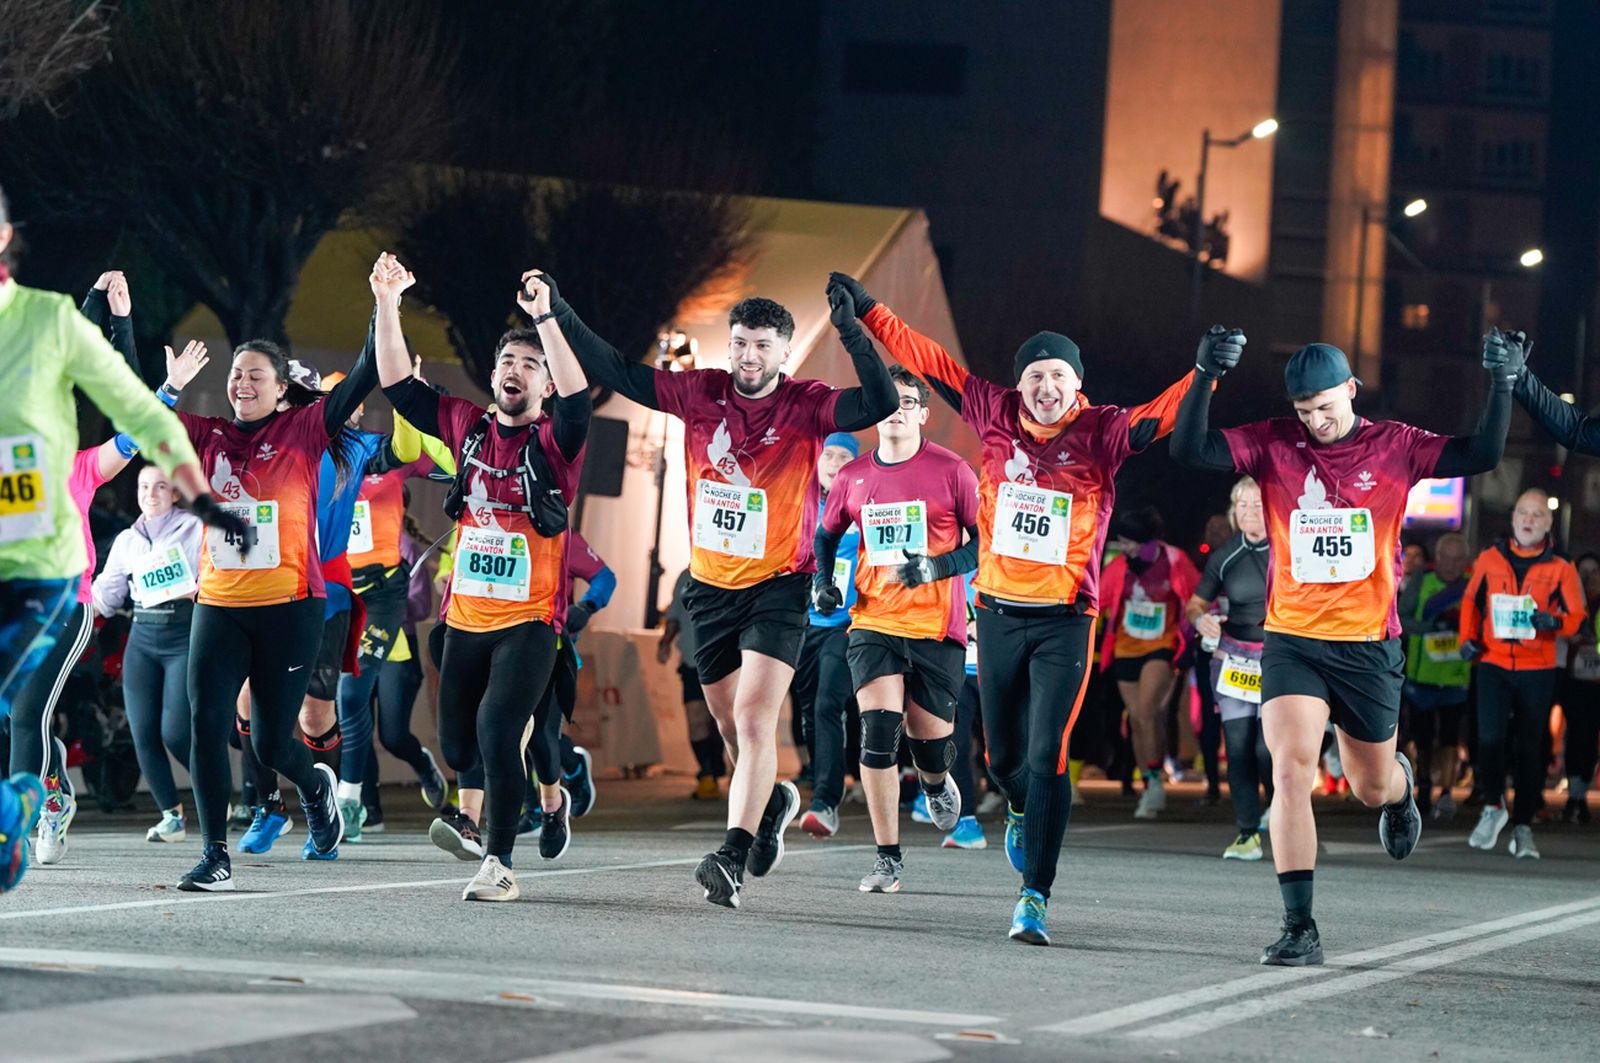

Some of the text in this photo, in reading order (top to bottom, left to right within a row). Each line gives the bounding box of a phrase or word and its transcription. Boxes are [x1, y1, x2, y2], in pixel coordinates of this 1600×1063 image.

[716, 457, 736, 475] 43
[0, 474, 35, 503] 46
[221, 481, 240, 499] 43
[710, 490, 741, 501] NOCHE DE
[475, 506, 492, 526] 43
[712, 508, 746, 532] 457
[1011, 511, 1051, 537] 456
[1333, 517, 1343, 525] DE
[876, 524, 912, 544] 7927
[1300, 525, 1316, 534] SAN
[1312, 535, 1353, 557] 455
[142, 562, 184, 588] 12693
[469, 552, 517, 578] 8307
